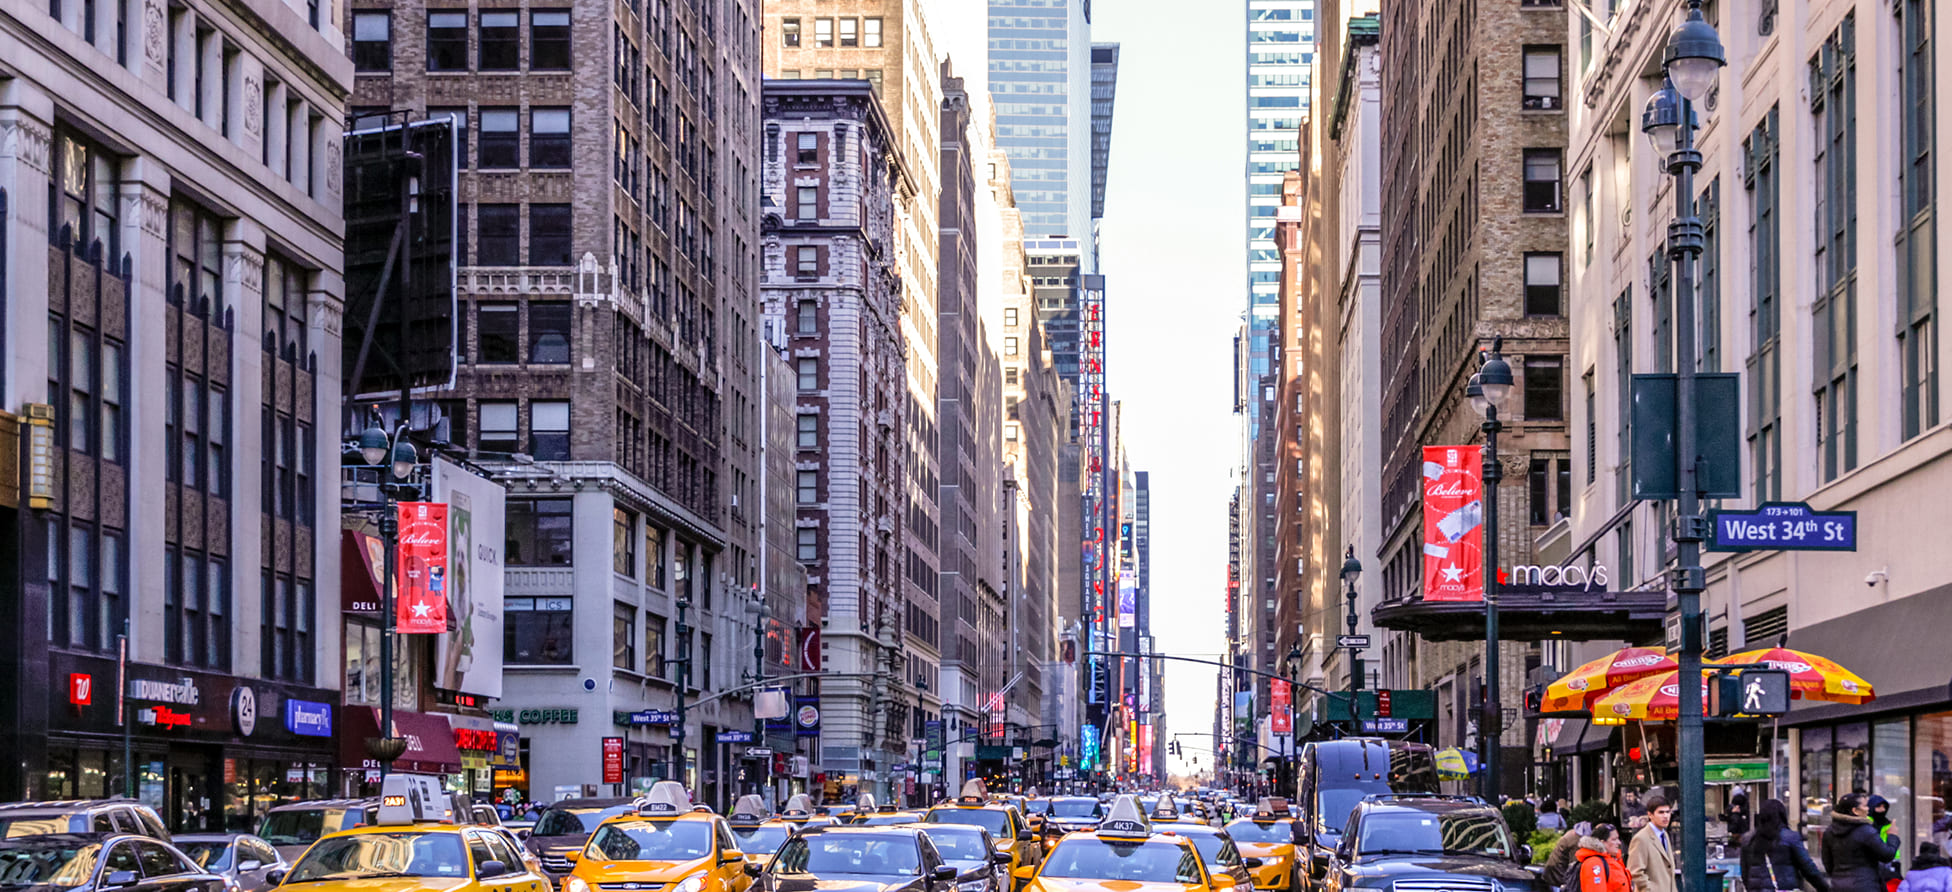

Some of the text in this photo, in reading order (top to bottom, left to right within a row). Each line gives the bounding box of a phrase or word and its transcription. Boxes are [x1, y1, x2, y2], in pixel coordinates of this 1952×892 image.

[1089, 304, 1102, 428] ERNST
[1426, 480, 1476, 496] Believe
[1766, 507, 1803, 517] 173 101
[401, 531, 441, 544] Believe
[1725, 520, 1845, 542] West 34th St
[1513, 560, 1608, 592] macy's
[353, 602, 376, 610] DELI
[241, 695, 252, 717] 24
[1665, 706, 1679, 714] Bee
[294, 704, 321, 731] pharmacy
[519, 709, 579, 725] COFFEE
[632, 714, 650, 722] West
[384, 796, 405, 806] 2A31
[1114, 822, 1134, 830] 4K37
